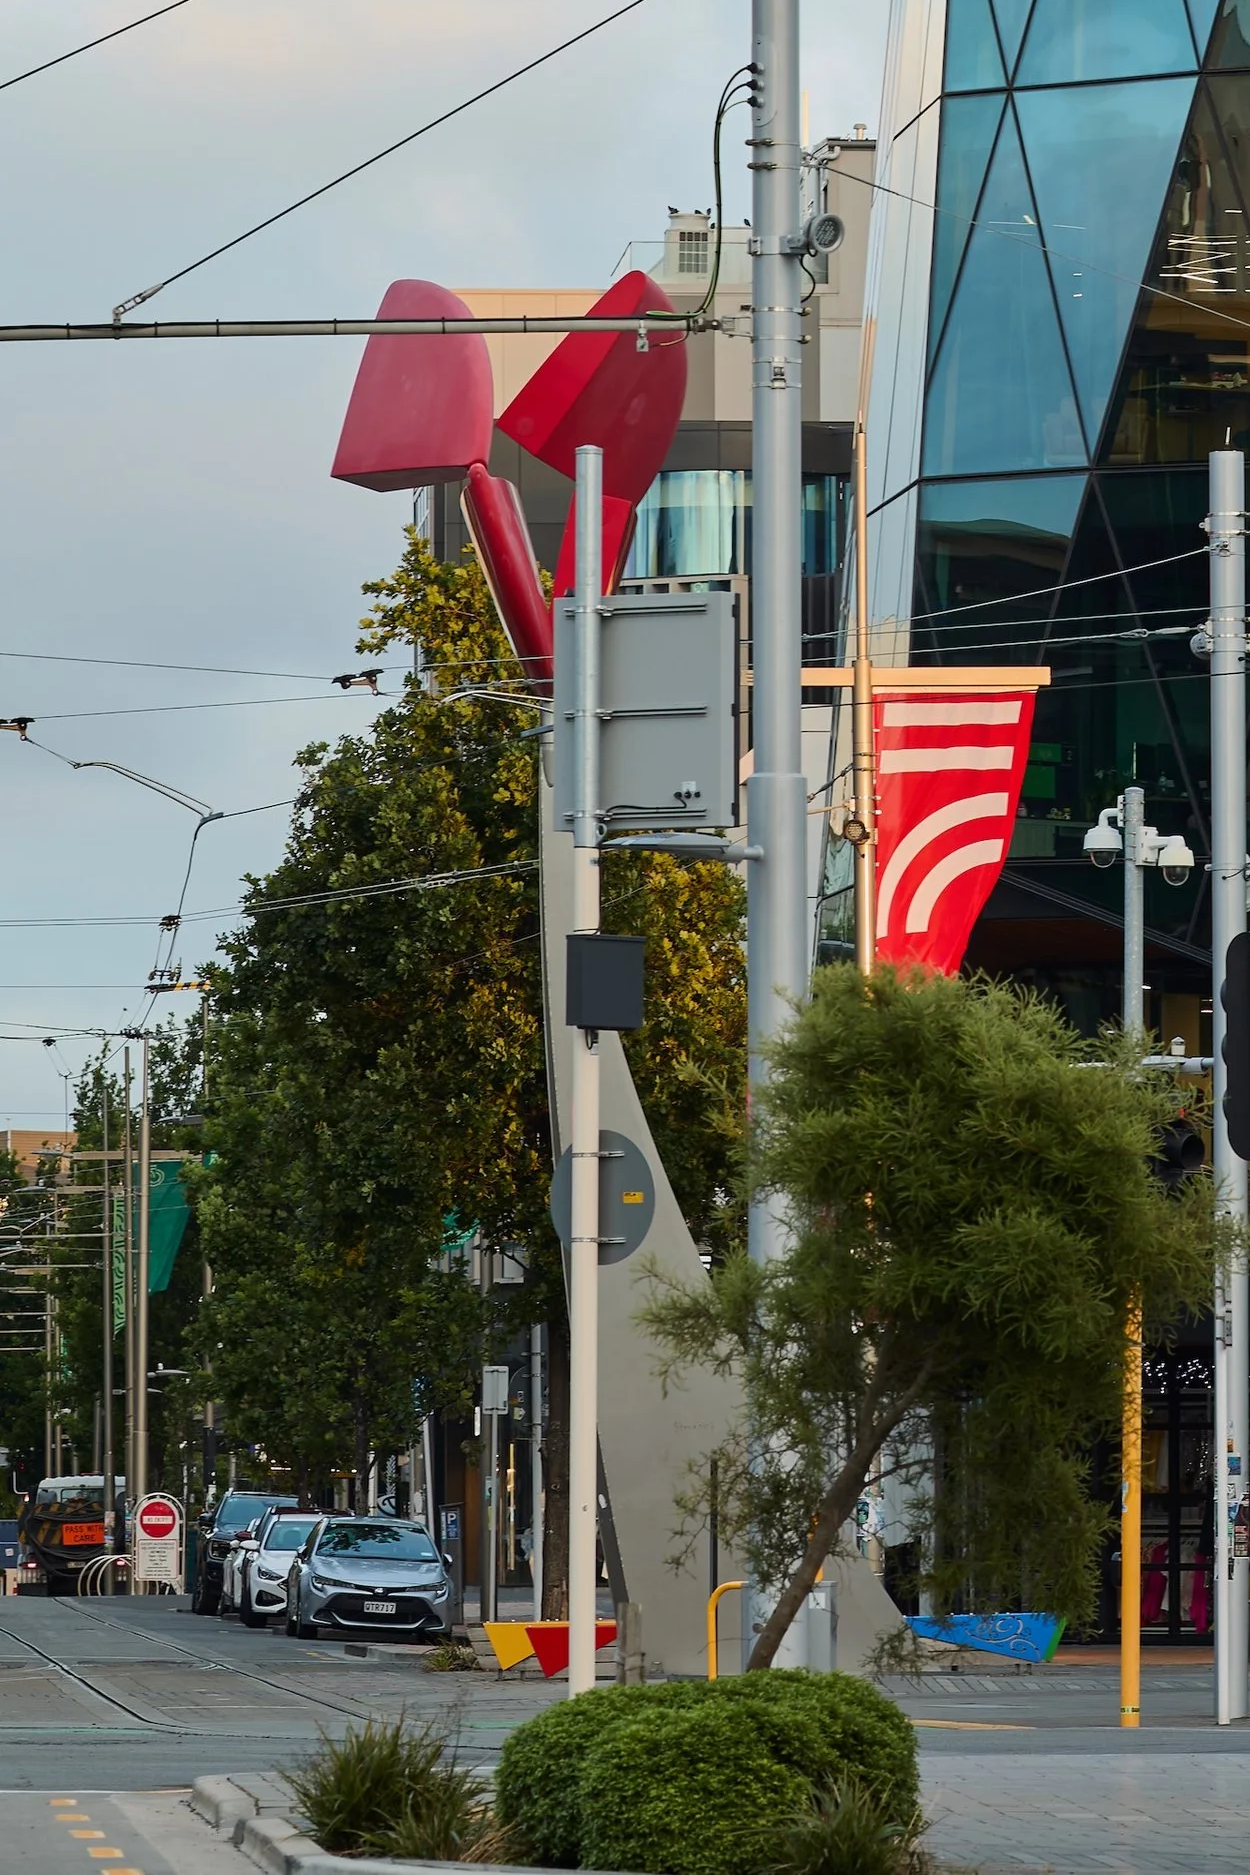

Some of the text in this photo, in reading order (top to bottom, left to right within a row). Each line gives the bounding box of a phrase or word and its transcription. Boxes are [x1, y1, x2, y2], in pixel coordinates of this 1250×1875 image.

[447, 1513, 457, 1524] P
[65, 1525, 104, 1534] PASS WITH
[74, 1534, 96, 1542] CARE
